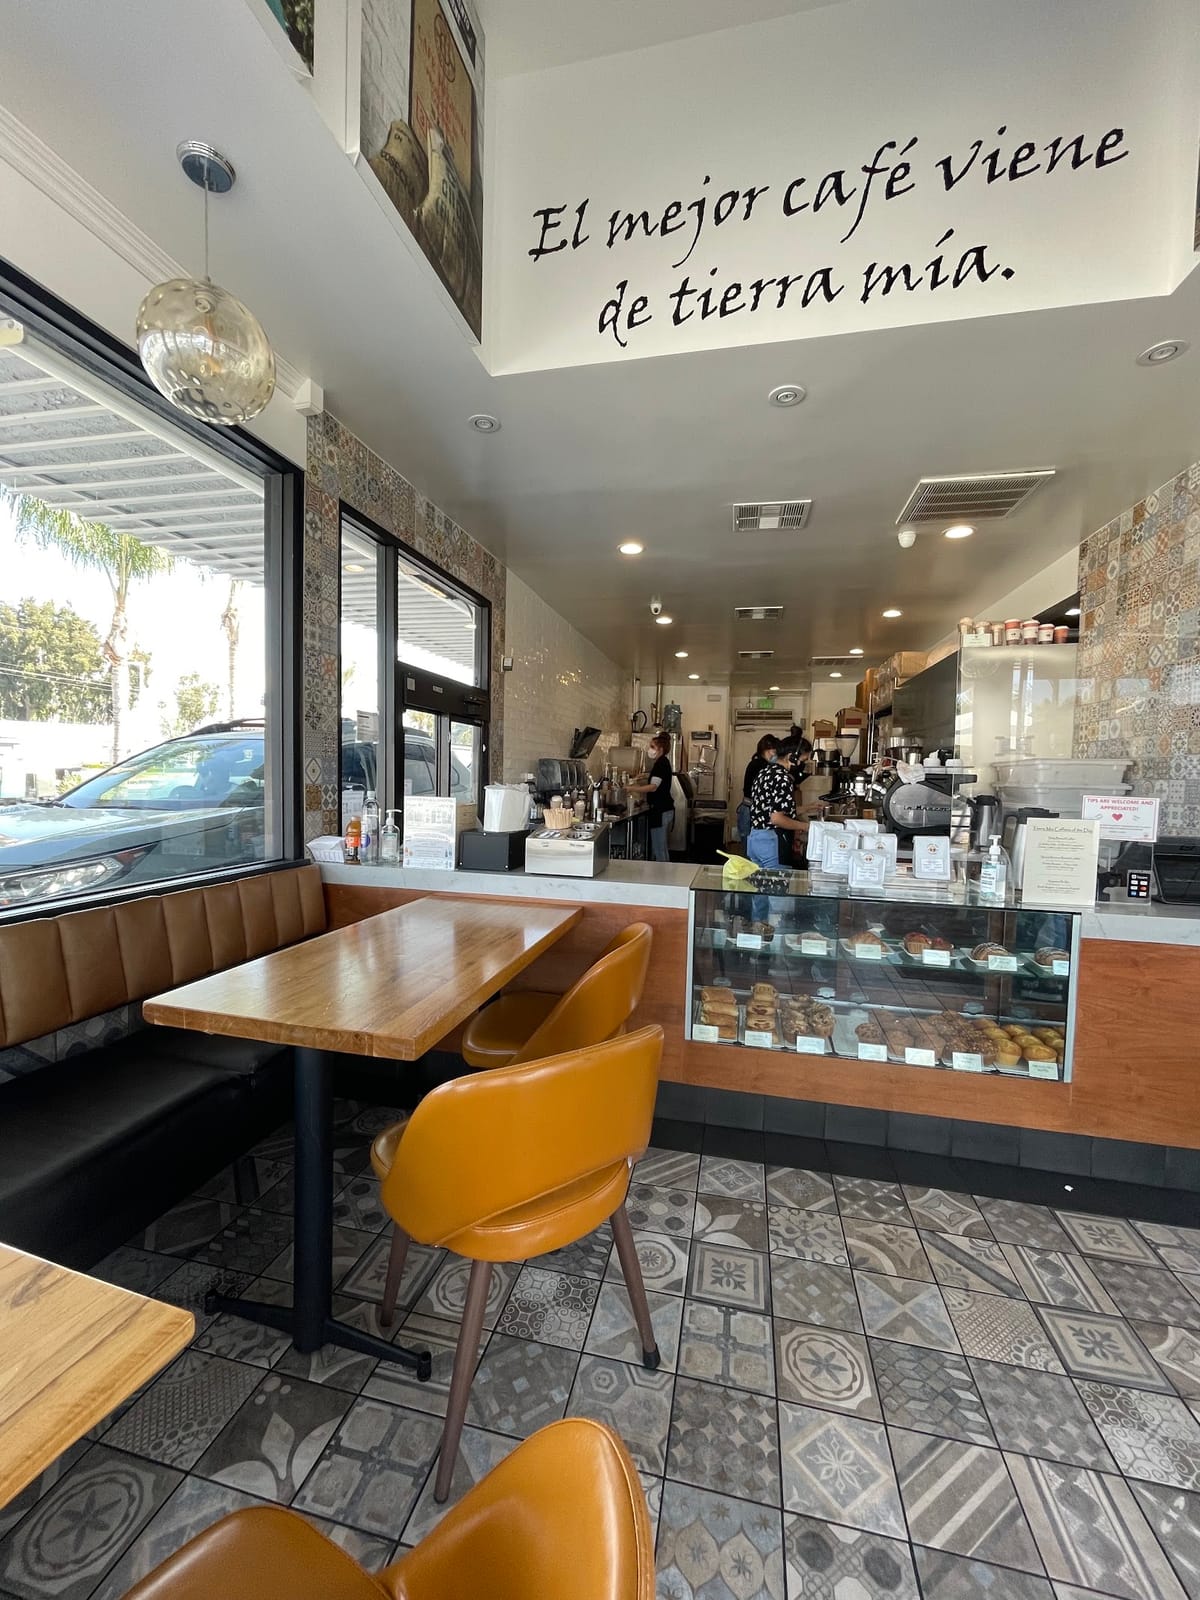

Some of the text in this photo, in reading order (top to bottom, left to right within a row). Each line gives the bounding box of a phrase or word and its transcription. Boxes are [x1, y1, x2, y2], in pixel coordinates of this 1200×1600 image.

[529, 199, 590, 262] El
[606, 175, 770, 269] mejor
[782, 136, 919, 243] café
[935, 125, 1129, 191] viene
[598, 228, 1015, 348] de tierra mía.
